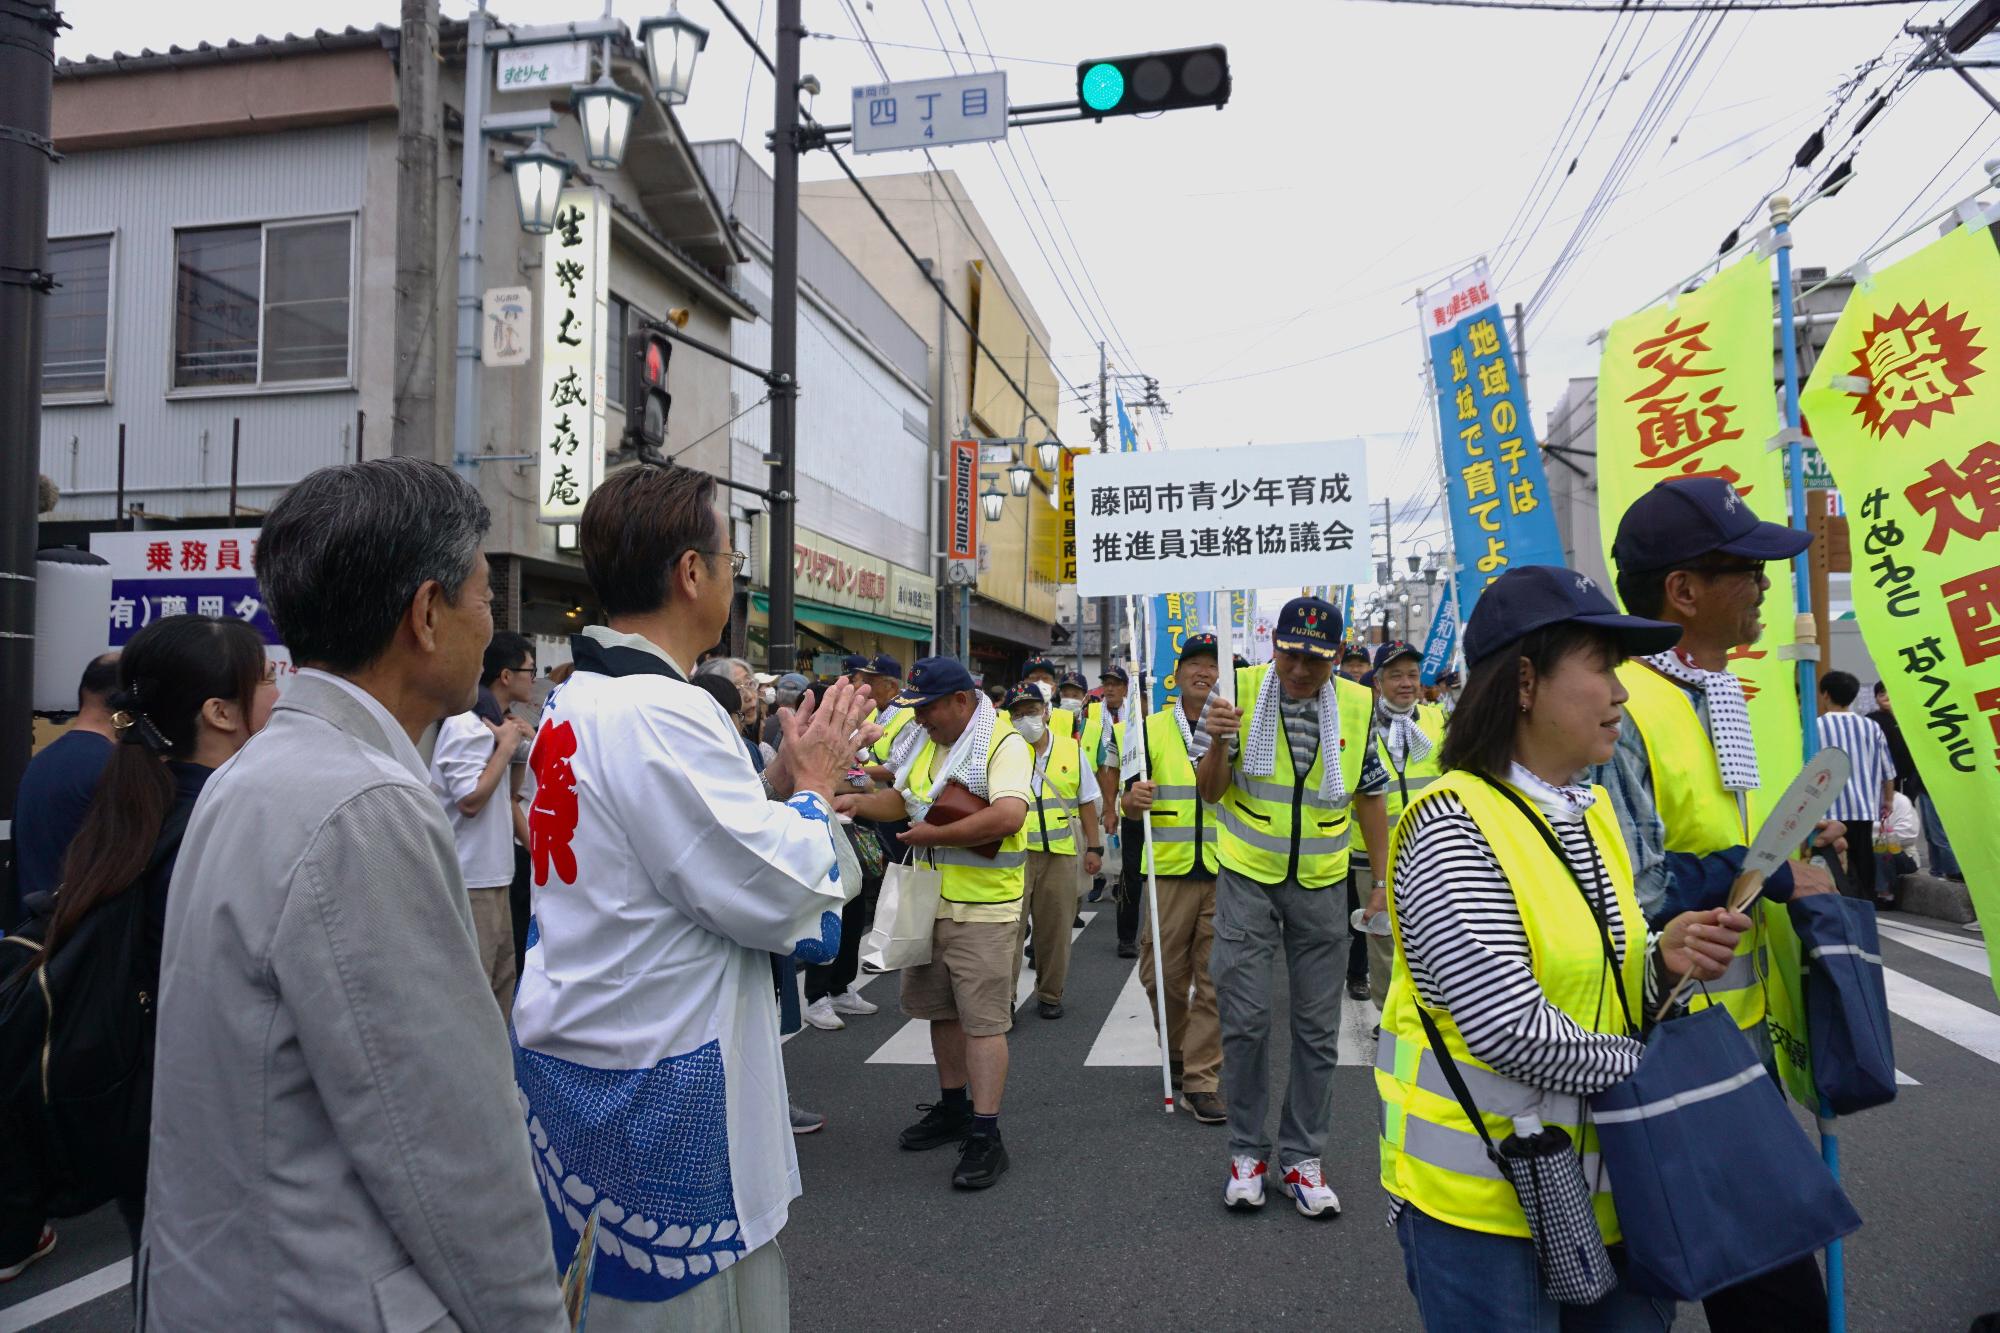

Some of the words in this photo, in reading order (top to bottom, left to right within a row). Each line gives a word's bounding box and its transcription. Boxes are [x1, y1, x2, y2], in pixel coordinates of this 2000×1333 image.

[870, 88, 987, 126] 四丁目
[924, 124, 934, 139] 4
[1468, 318, 1539, 515] 地域の子は
[956, 447, 974, 555] BRIDGESTONE
[1091, 472, 1352, 517] 藤岡市青少年育成
[147, 539, 258, 572] 乗務員
[1092, 520, 1354, 563] 推進員連絡協議会
[1290, 627, 1327, 640] FUJIOKA
